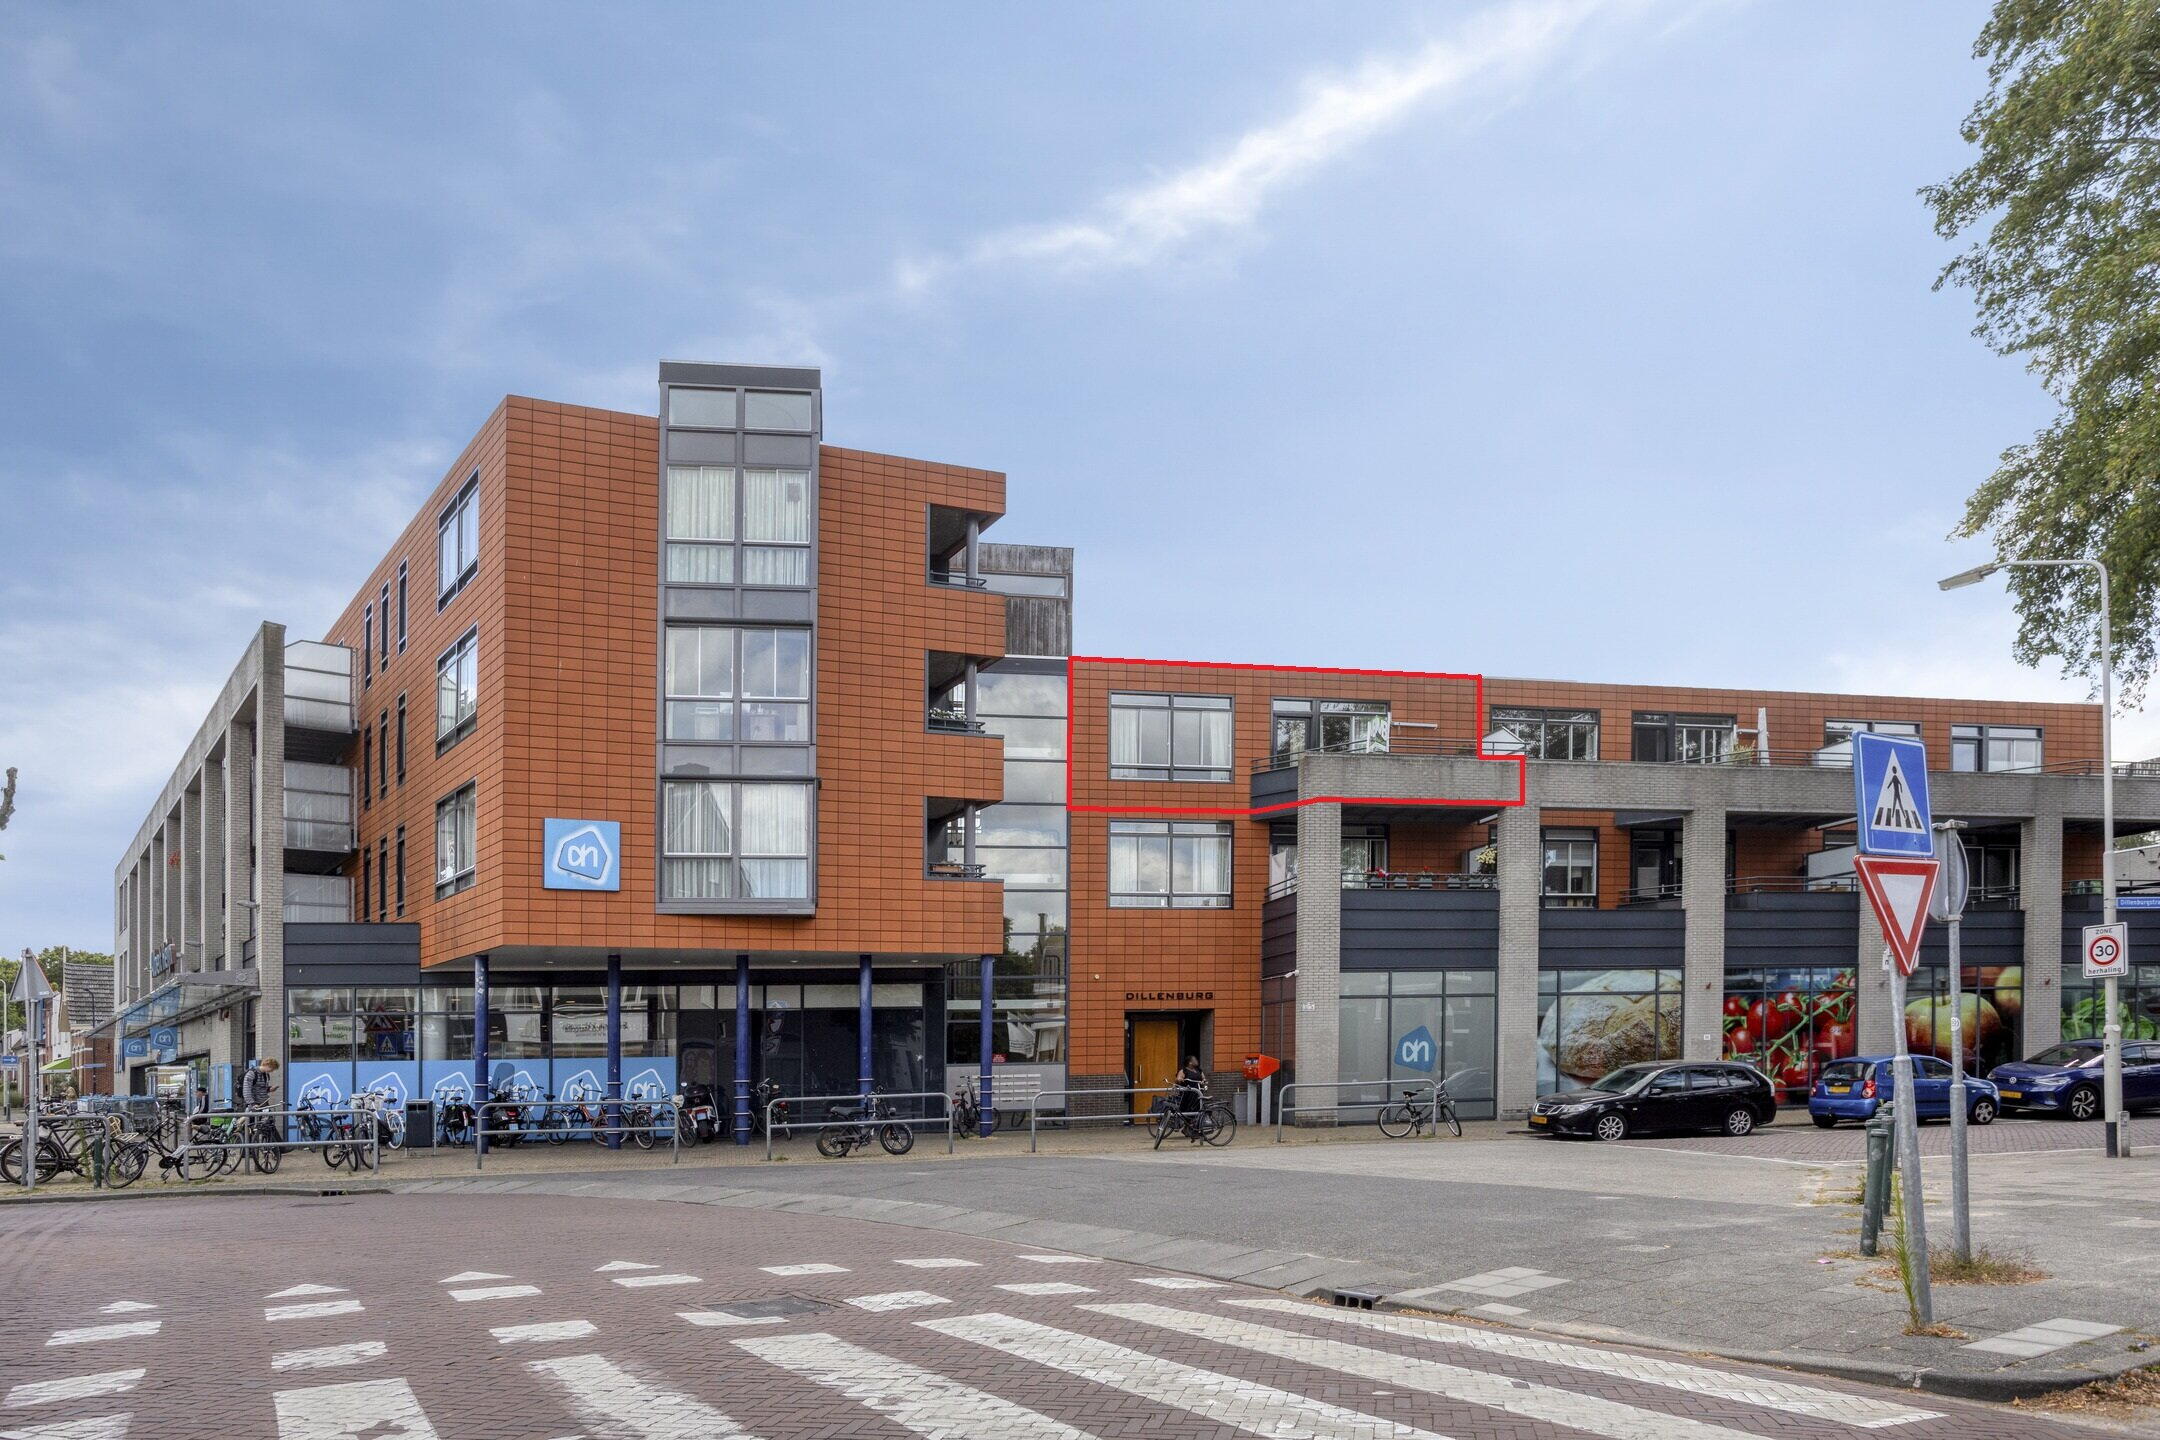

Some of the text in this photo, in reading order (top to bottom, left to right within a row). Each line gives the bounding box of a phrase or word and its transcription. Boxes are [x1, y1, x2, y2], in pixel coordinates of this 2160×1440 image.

[2095, 945, 2114, 957] 30
[2088, 967, 2121, 975] herhaling
[1126, 992, 1214, 1000] DILLENBURG
